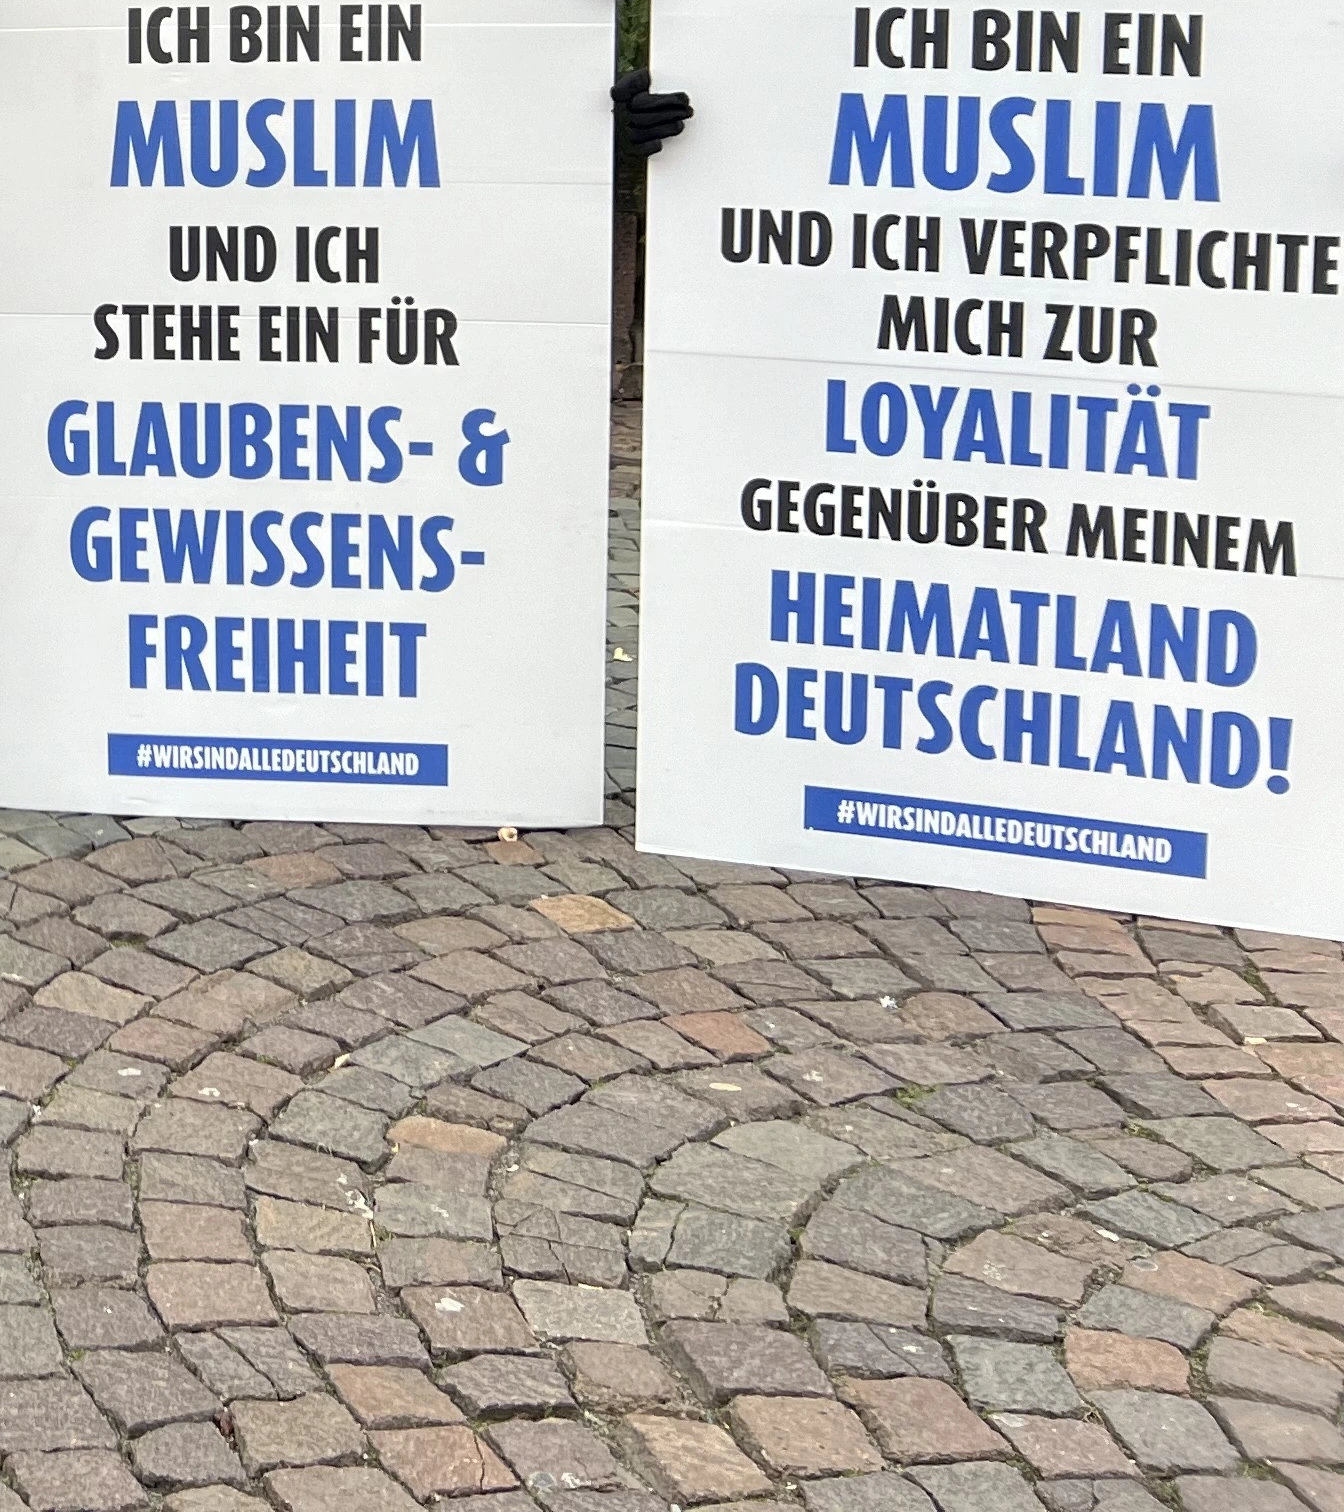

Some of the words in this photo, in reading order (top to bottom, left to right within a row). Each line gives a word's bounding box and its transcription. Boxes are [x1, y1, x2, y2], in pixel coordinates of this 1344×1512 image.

[129, 7, 209, 63] ICH
[230, 5, 319, 63] BIN
[340, 4, 421, 61] EIN
[854, 8, 949, 69] ICH
[972, 9, 1079, 73] BIN
[1103, 13, 1202, 77] EIN
[111, 99, 440, 187] MUSLIM
[829, 93, 1219, 202] MUSLIM
[170, 226, 276, 282] UND
[296, 226, 378, 283] ICH
[722, 208, 832, 266] UND
[852, 214, 940, 272] ICH
[960, 218, 1339, 295] VERPFLICHTE
[94, 304, 240, 360] STEHE
[259, 306, 338, 362] EIN
[359, 296, 459, 365] FÜR
[877, 295, 1023, 357] MICH
[1043, 304, 1157, 367] ZUR
[48, 400, 432, 483] GLAUBENS-
[459, 409, 509, 486] &
[827, 380, 1209, 480] LOYALITÄT
[70, 507, 484, 592] GEWISSENS-
[741, 479, 1048, 554] GEGENÜBER
[1066, 503, 1296, 576] MEINEM
[129, 615, 426, 697] FREIHEIT
[771, 570, 1256, 687] HEIMATLAND
[137, 744, 419, 775] #WIRSINDALLEDEUTSCHLAND
[735, 663, 1292, 794] DEUTSCHLAND!
[837, 800, 1171, 863] #WIRSINDALLEDEUTSCHLAND
